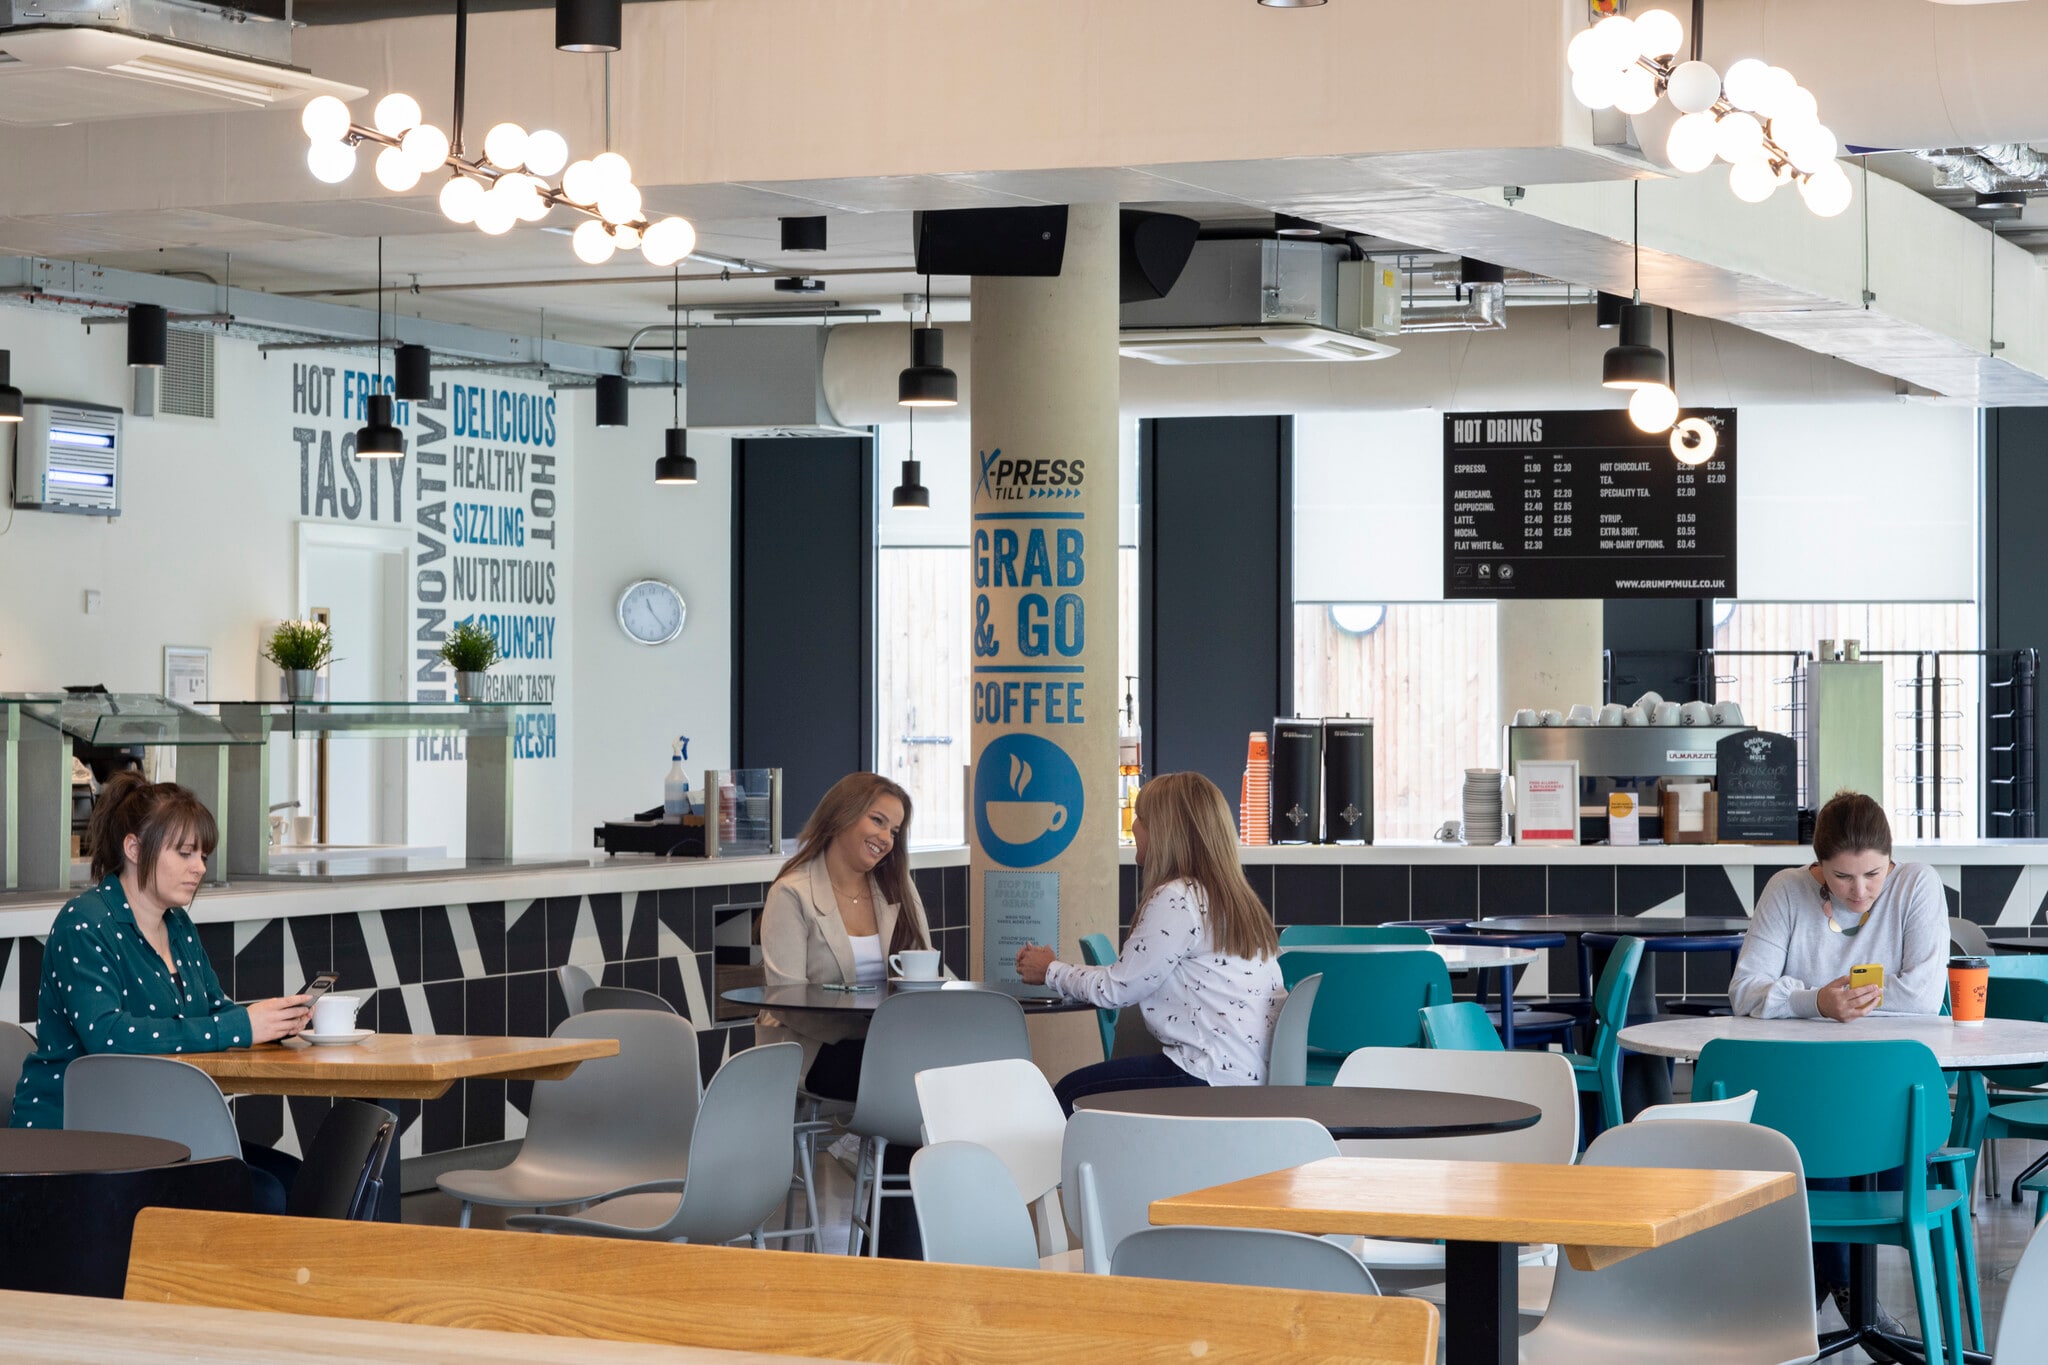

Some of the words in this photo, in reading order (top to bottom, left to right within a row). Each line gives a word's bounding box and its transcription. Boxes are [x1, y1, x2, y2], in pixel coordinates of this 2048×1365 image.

[293, 362, 335, 416] HOT
[454, 384, 556, 447] DELICIOUS
[1454, 419, 1482, 443] HOT
[1486, 418, 1542, 443] DRINKS
[293, 427, 409, 522] TASTY
[453, 446, 526, 493] HEALTHY
[974, 448, 1085, 504] X-PRESS
[1454, 464, 1487, 473] ESPRESSO.
[1600, 463, 1612, 472] HOT
[1614, 462, 1651, 472] CHOCOLATE.
[1707, 461, 1725, 471] £2.55
[1600, 475, 1614, 484] TEA.
[1677, 475, 1694, 484] £1.95
[1707, 474, 1726, 483] £2.00
[531, 453, 556, 549] HOT
[995, 487, 1024, 500] TILL
[1454, 490, 1492, 499] AMERICANO.
[1524, 489, 1541, 498] £1.75
[1553, 489, 1572, 498] £2.20
[1600, 488, 1636, 497] SPECIALITY
[1637, 488, 1651, 497] TEA.
[1677, 487, 1696, 497] £2.00
[1454, 502, 1495, 512] CAPPUCCINO.
[1524, 502, 1543, 511] £2.40
[1600, 514, 1623, 524] SYRUP.
[1677, 513, 1696, 523] £0.50
[453, 502, 524, 547] SIZZLING
[1454, 515, 1475, 525] LATTE.
[1524, 515, 1543, 524] £2.40
[1454, 528, 1478, 538] MOCHA.
[1524, 527, 1543, 537] £2.40
[1600, 527, 1620, 536] EXTRA
[1621, 527, 1640, 536] SHOT.
[1677, 526, 1696, 536] £0.55
[417, 382, 447, 702] INNOVATIVE
[1454, 541, 1469, 550] FLAT
[1471, 540, 1491, 550] WHITE
[1524, 540, 1543, 549] £2.30
[1600, 540, 1635, 549] NON-DAIRY
[1636, 539, 1665, 549] OPTIONS.
[1677, 539, 1696, 549] £0.45
[974, 528, 1085, 588] GRAB
[453, 556, 556, 605] NUTRITIOUS
[1616, 579, 1725, 588] WWW.GRUMPYMULE.CO.UK
[478, 614, 556, 660] CRUNCHY
[974, 593, 1000, 657] &
[1017, 593, 1085, 657] GO
[484, 674, 523, 702] RGANIC
[526, 675, 556, 702] TASTY
[974, 682, 1085, 724] COFFEE
[514, 713, 556, 759] RESH
[1743, 737, 1772, 749] GRUMPY
